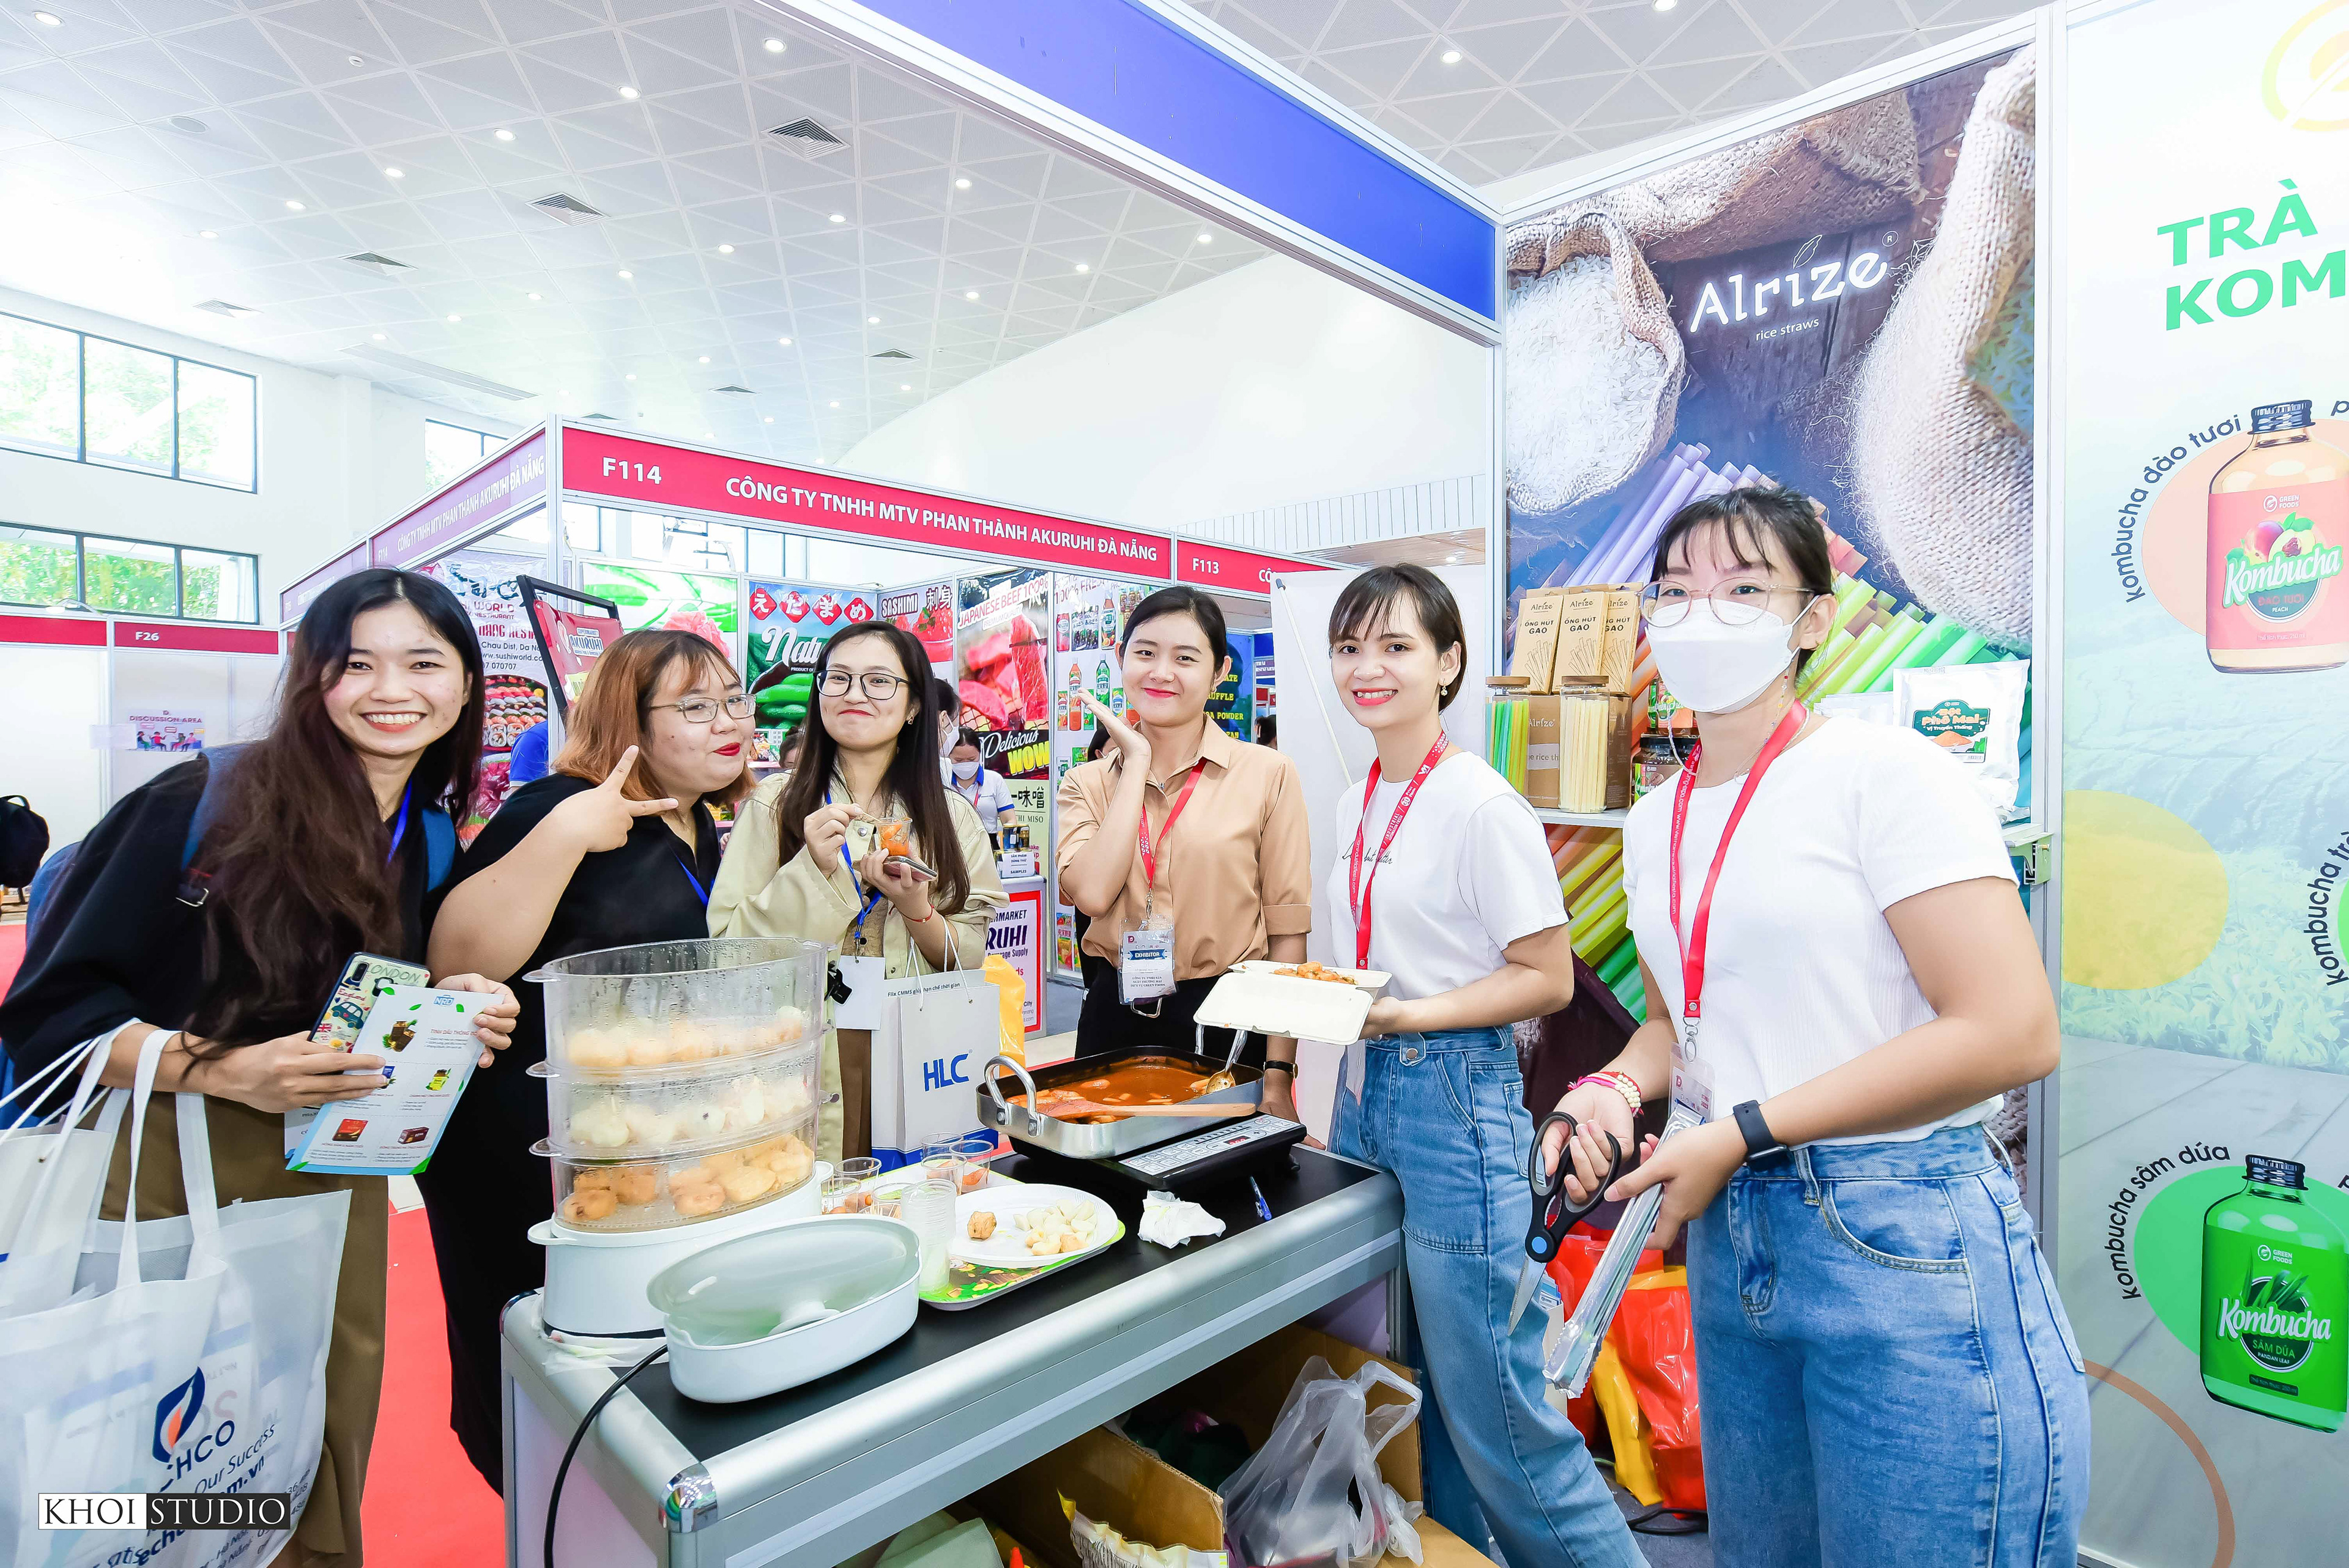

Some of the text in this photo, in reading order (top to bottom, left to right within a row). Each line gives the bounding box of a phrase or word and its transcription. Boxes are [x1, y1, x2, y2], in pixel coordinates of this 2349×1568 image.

[2157, 178, 2318, 267] TRÀ
[1689, 250, 1888, 333] Alrize
[2165, 250, 2349, 331] KOM
[1756, 317, 1820, 341] rice straws
[397, 534, 411, 553] CÔNG
[410, 528, 417, 545] TY
[417, 522, 431, 541] TNHH
[430, 516, 443, 536] MTV
[442, 505, 458, 528] PHAN
[458, 494, 480, 520] THÀNH
[480, 476, 510, 508] AKURUHI
[510, 465, 521, 492] ĐÀ
[521, 453, 545, 484] NẴNG
[602, 456, 1158, 561] F114 CÔNG TY TNHH MTV PHAN THÀNH AKURUHI ĐÀ NẴNG
[2110, 413, 2241, 603] kombucha đào tươi
[1193, 558, 1271, 583] F113 CÔ
[2224, 547, 2340, 605] Kombucha
[752, 593, 866, 621] えだまめ
[882, 593, 918, 617] SASHIMI
[926, 585, 953, 612] 刺身
[959, 597, 1000, 627] JAPANESE
[1001, 587, 1022, 609] BEEF
[1531, 601, 1554, 611] Alrize
[1569, 597, 1594, 608] Alrize
[135, 631, 160, 642] F26
[1529, 627, 1548, 636] GẠO
[1569, 624, 1590, 634] GẠO
[570, 635, 604, 652] AKURUHI
[761, 624, 827, 668] Natu
[1217, 712, 1244, 720] POWDER
[1952, 714, 1980, 724] Mai
[984, 730, 1039, 759] Delicious
[1007, 740, 1050, 776] WOW
[1385, 813, 1400, 839] INDUSTRIAL
[2303, 861, 2349, 986] kombucha
[985, 925, 1028, 950] RUHI
[1012, 947, 1028, 957] Supply
[366, 962, 421, 983] LONDON
[922, 1052, 970, 1092] HLC
[2103, 1141, 2230, 1300] kombucha sâm dứa
[2273, 1249, 2293, 1265] GREEN FOODS
[2218, 1297, 2332, 1341] Kombucha
[2252, 1339, 2273, 1353] SÂM
[2257, 1352, 2279, 1363] PANDAN
[194, 1424, 275, 1494] Our Success
